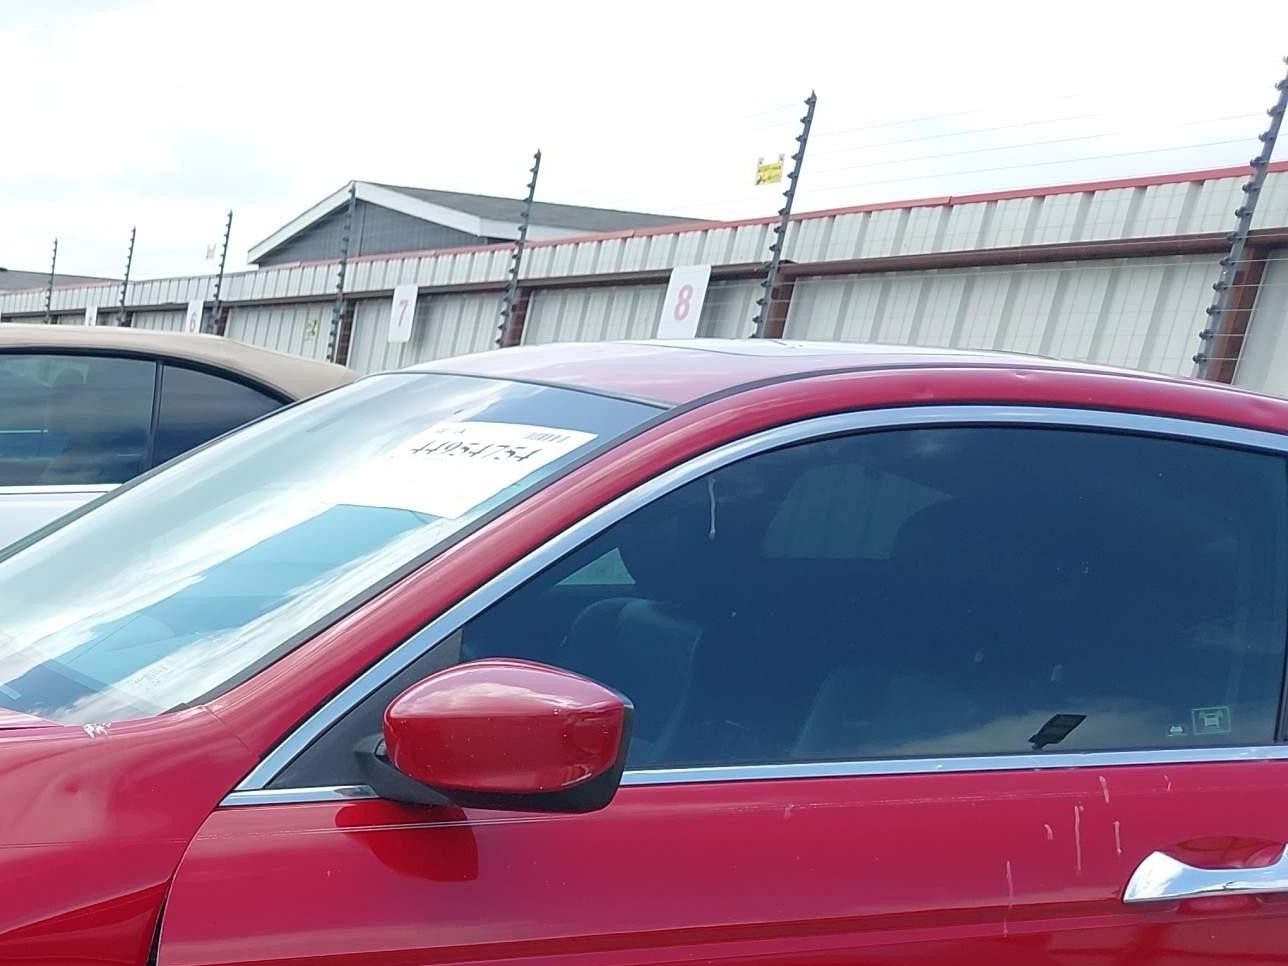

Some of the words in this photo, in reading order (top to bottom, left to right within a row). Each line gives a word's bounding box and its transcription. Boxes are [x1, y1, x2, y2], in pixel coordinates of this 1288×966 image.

[398, 299, 410, 328] 7
[673, 284, 694, 321] 8
[189, 311, 198, 333] 6
